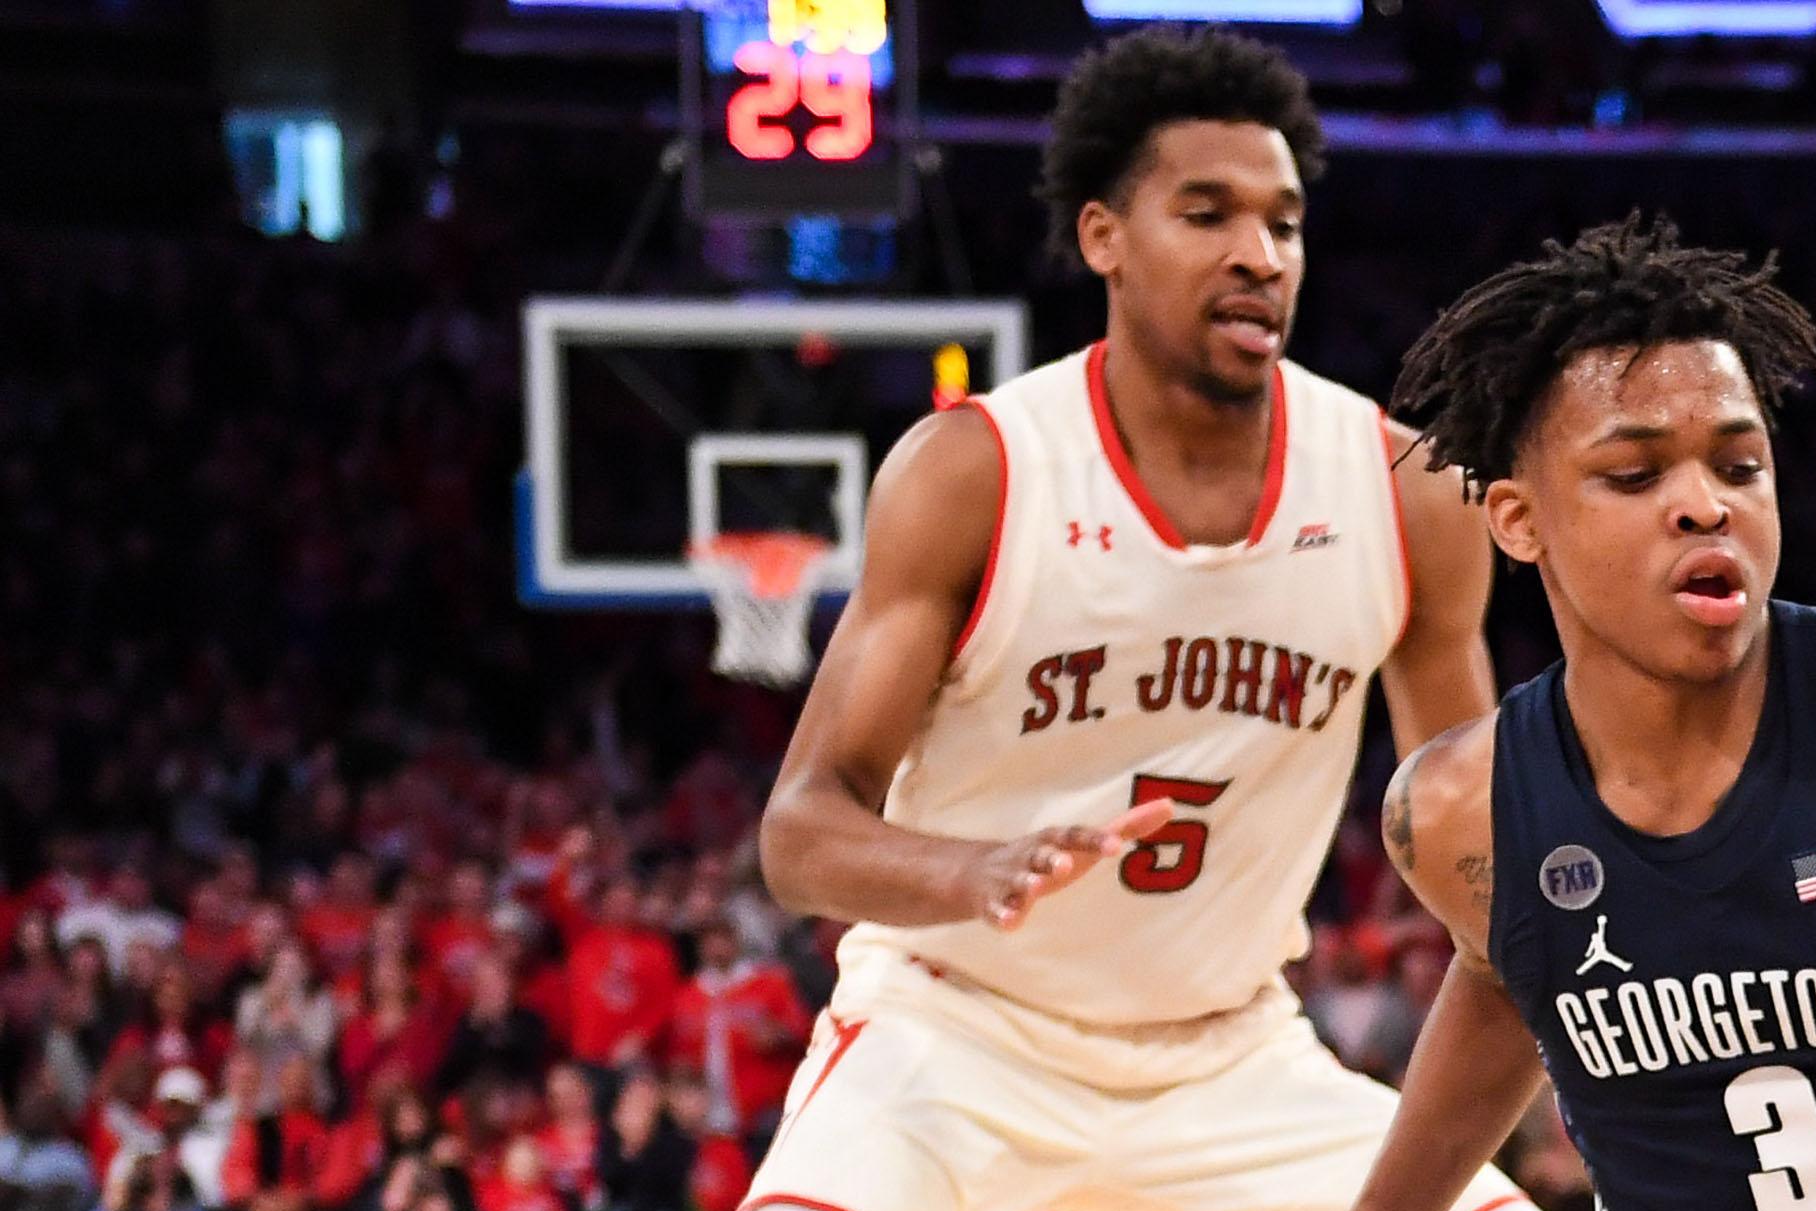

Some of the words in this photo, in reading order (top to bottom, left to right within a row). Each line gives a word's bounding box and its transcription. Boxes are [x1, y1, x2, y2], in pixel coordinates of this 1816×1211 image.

[726, 41, 873, 161] 29
[1019, 644, 1108, 736] ST.
[1136, 636, 1357, 732] JOHN'S
[1118, 773, 1235, 895] 5
[1545, 861, 1598, 897] FXR
